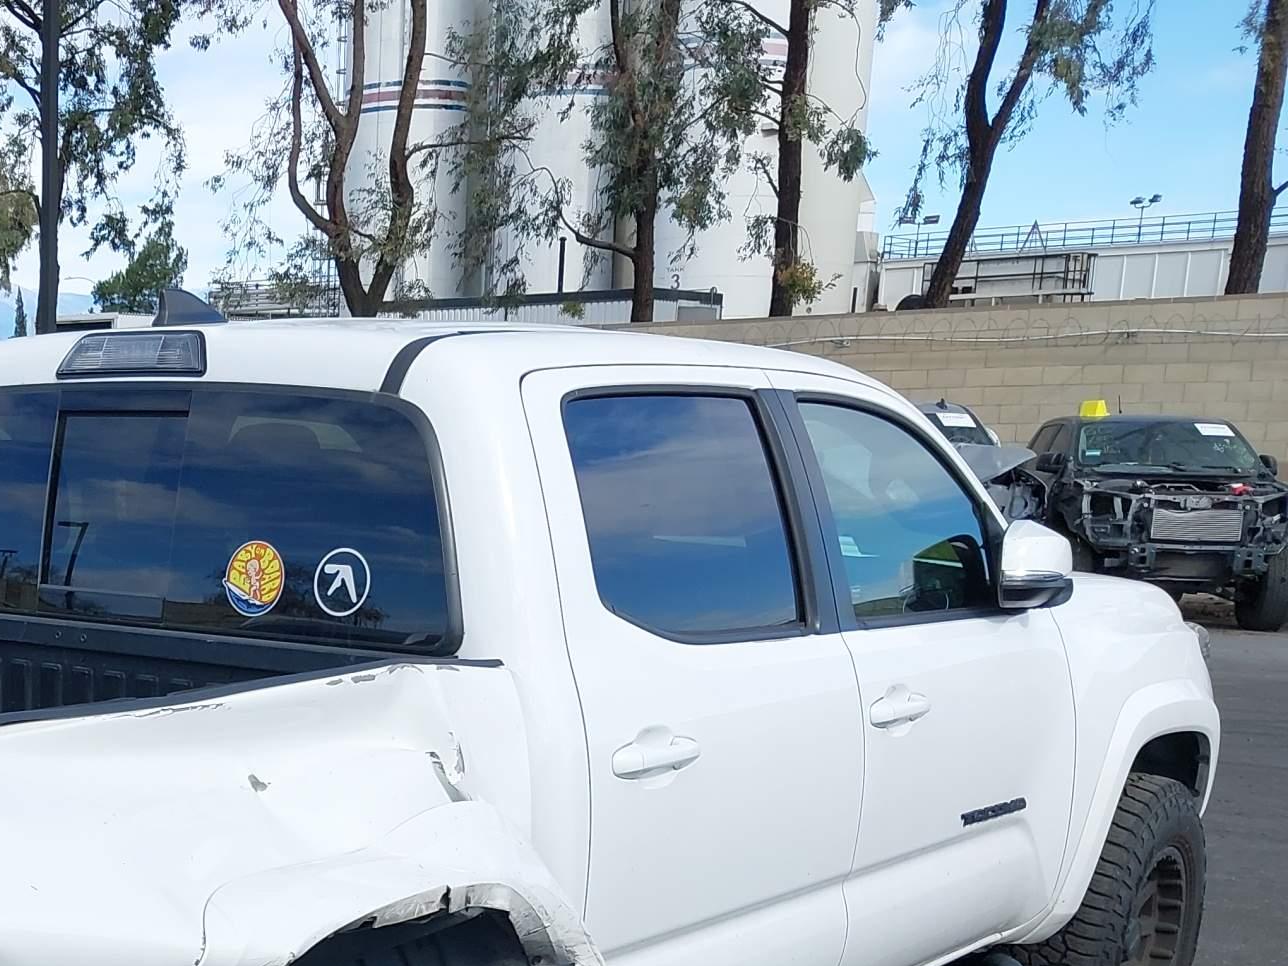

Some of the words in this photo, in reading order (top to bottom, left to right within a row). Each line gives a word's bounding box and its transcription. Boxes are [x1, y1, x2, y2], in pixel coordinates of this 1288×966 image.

[670, 273, 681, 290] 3
[229, 543, 258, 596] BABY
[259, 547, 281, 602] BOARD
